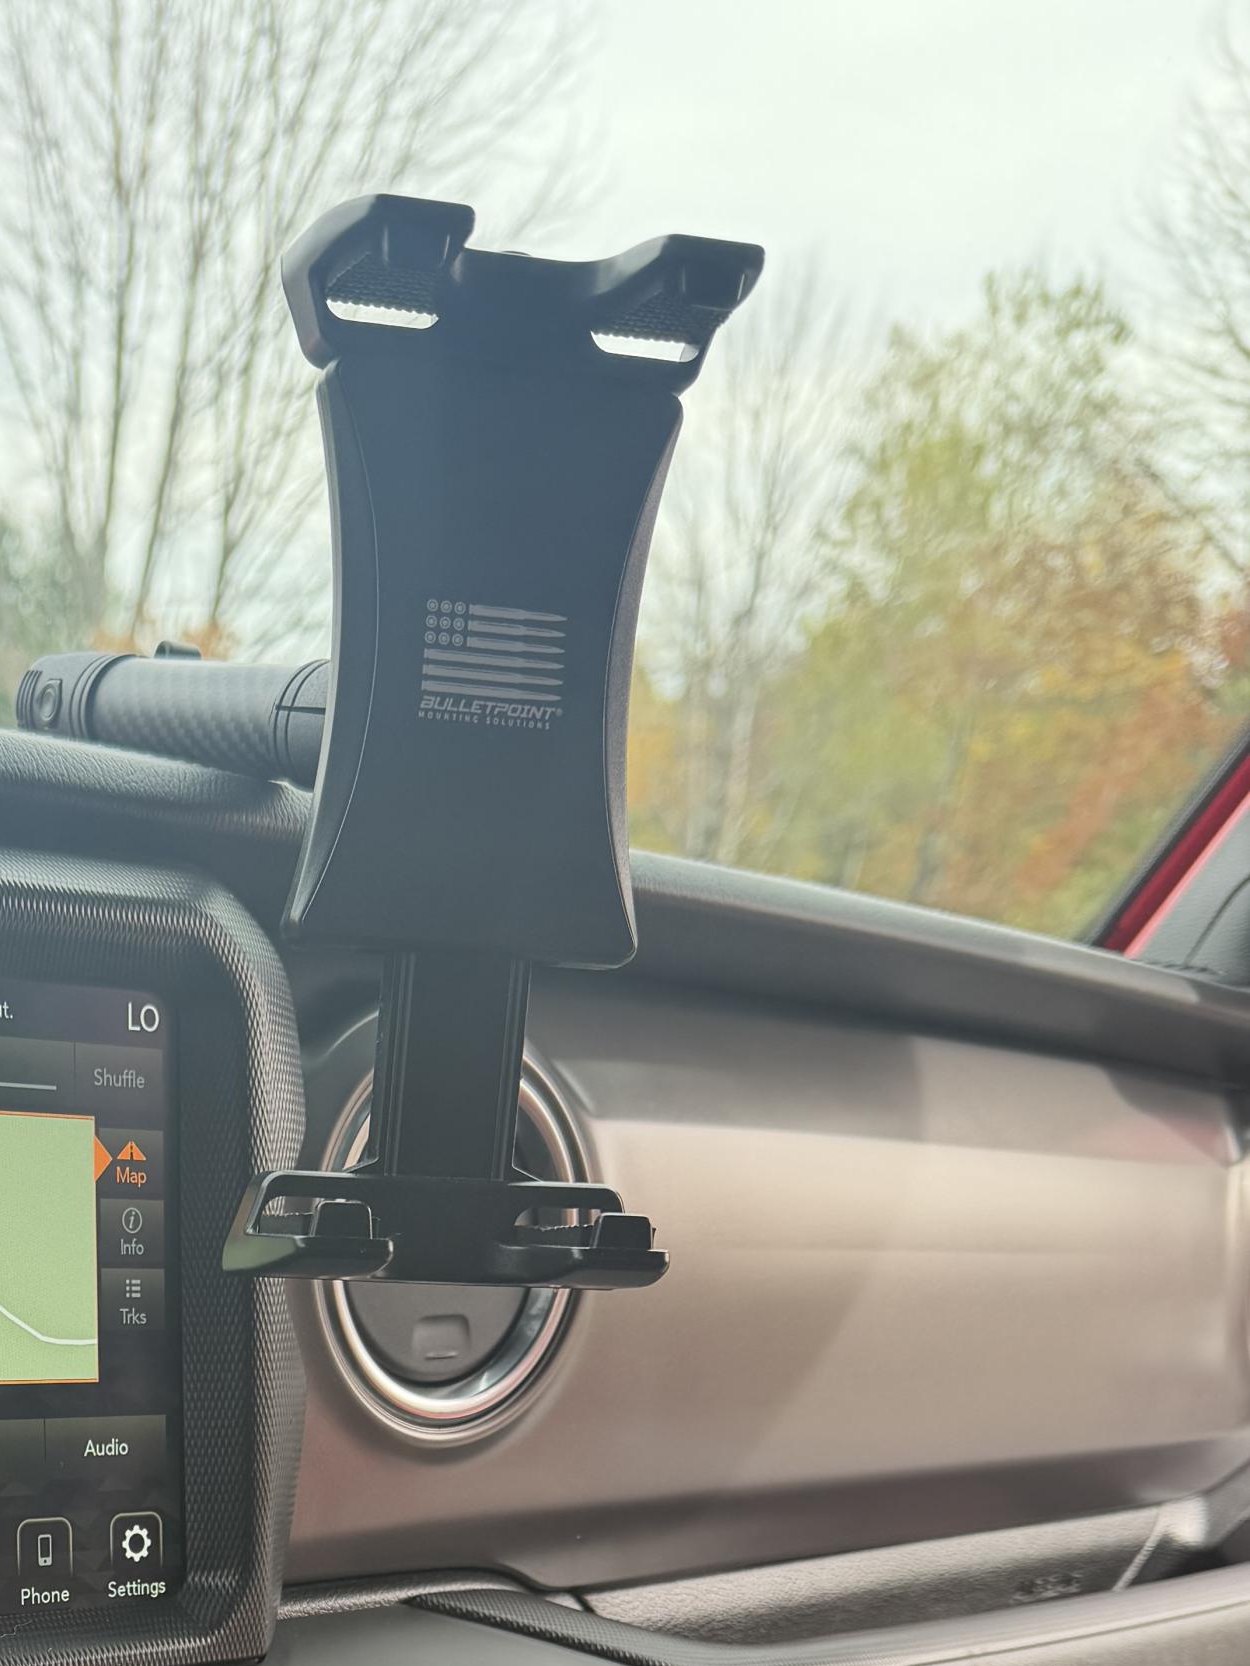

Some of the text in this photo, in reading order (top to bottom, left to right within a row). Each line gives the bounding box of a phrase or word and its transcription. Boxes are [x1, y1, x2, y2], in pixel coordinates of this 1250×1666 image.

[418, 710, 549, 730] MOUNTING SOLUTIONS
[127, 1002, 159, 1033] LO
[93, 1068, 145, 1089] Shuffle
[116, 1167, 147, 1188] Map
[120, 1239, 144, 1256] Info
[120, 1308, 147, 1325] Trks
[84, 1440, 129, 1457] Audio
[20, 1587, 70, 1606] Phone
[107, 1579, 166, 1599] Settings
